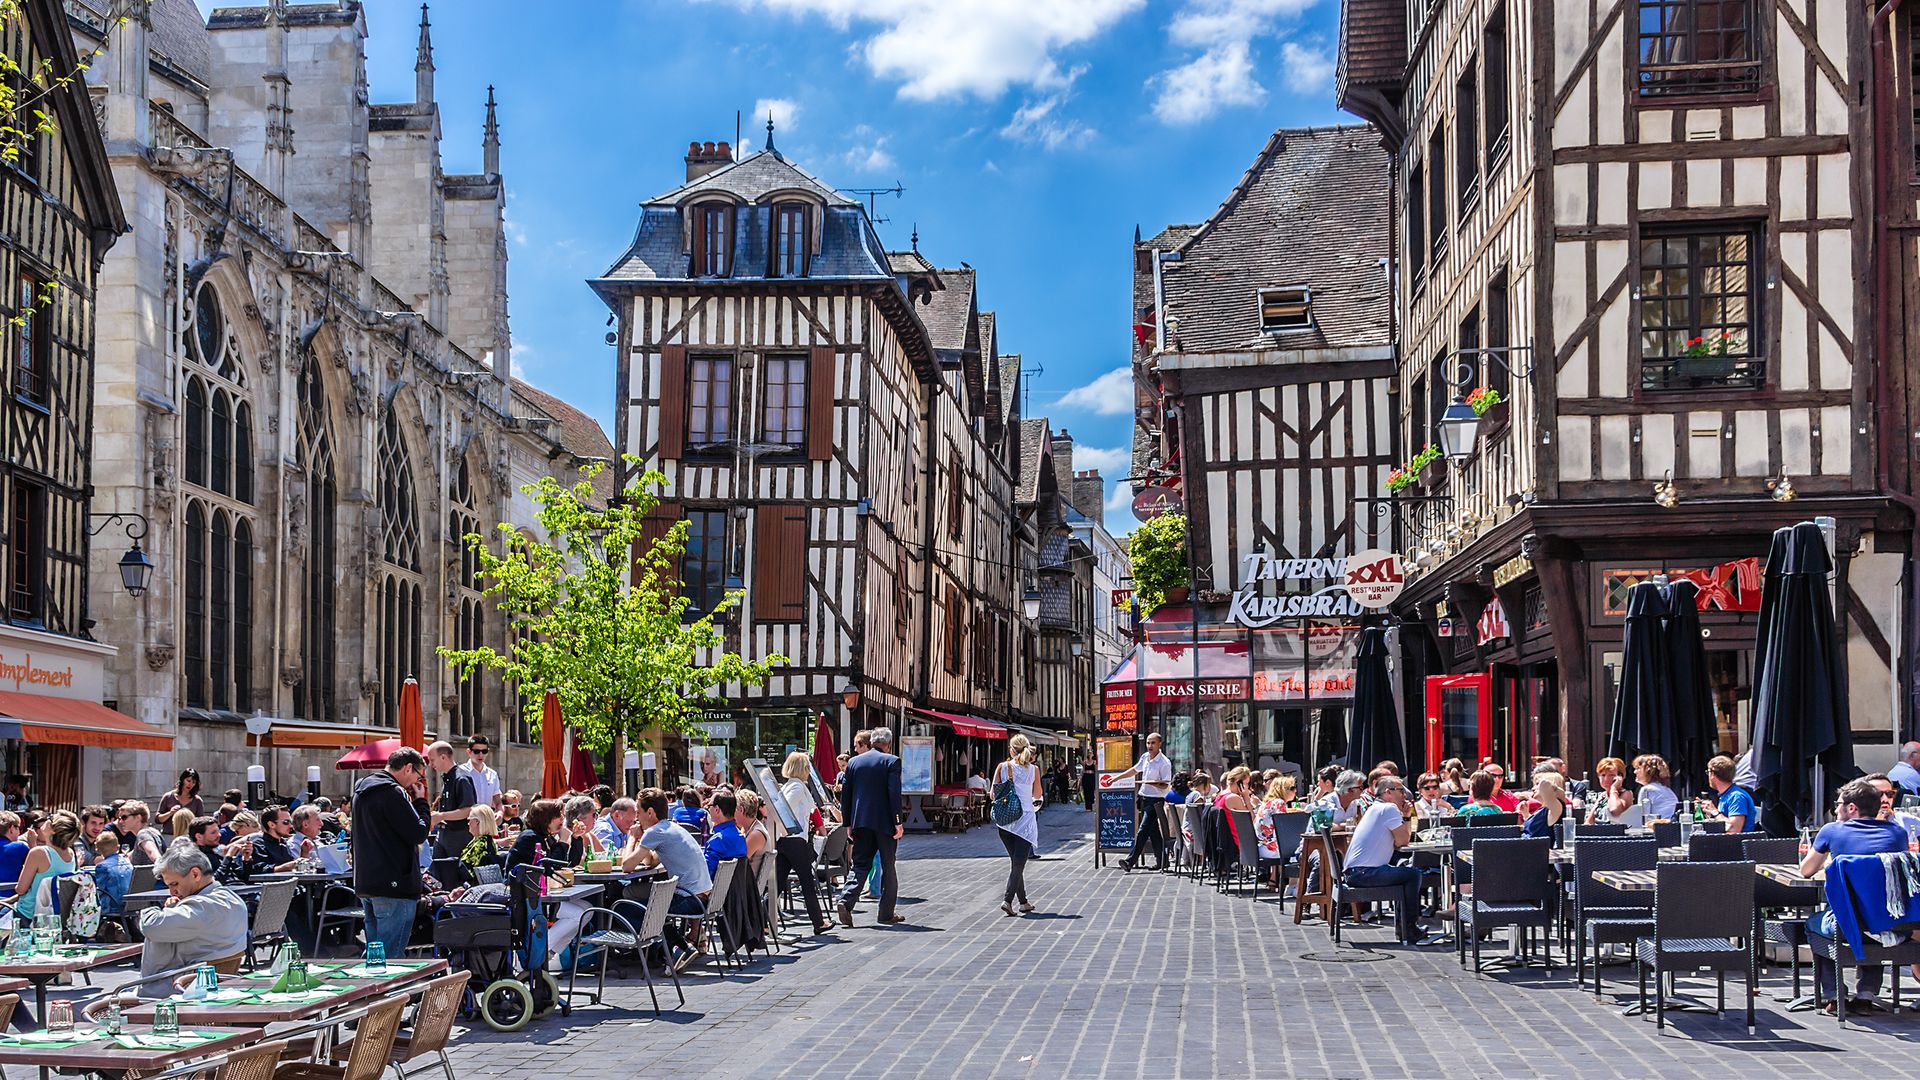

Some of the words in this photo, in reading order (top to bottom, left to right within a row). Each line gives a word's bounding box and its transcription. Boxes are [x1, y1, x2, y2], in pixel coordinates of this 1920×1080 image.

[1347, 557, 1403, 586] XXL
[1668, 557, 1761, 612] XL
[1368, 593, 1382, 601] BAR
[1157, 684, 1241, 697] BRASSERIE
[1106, 704, 1137, 713] RESTAURATIO
